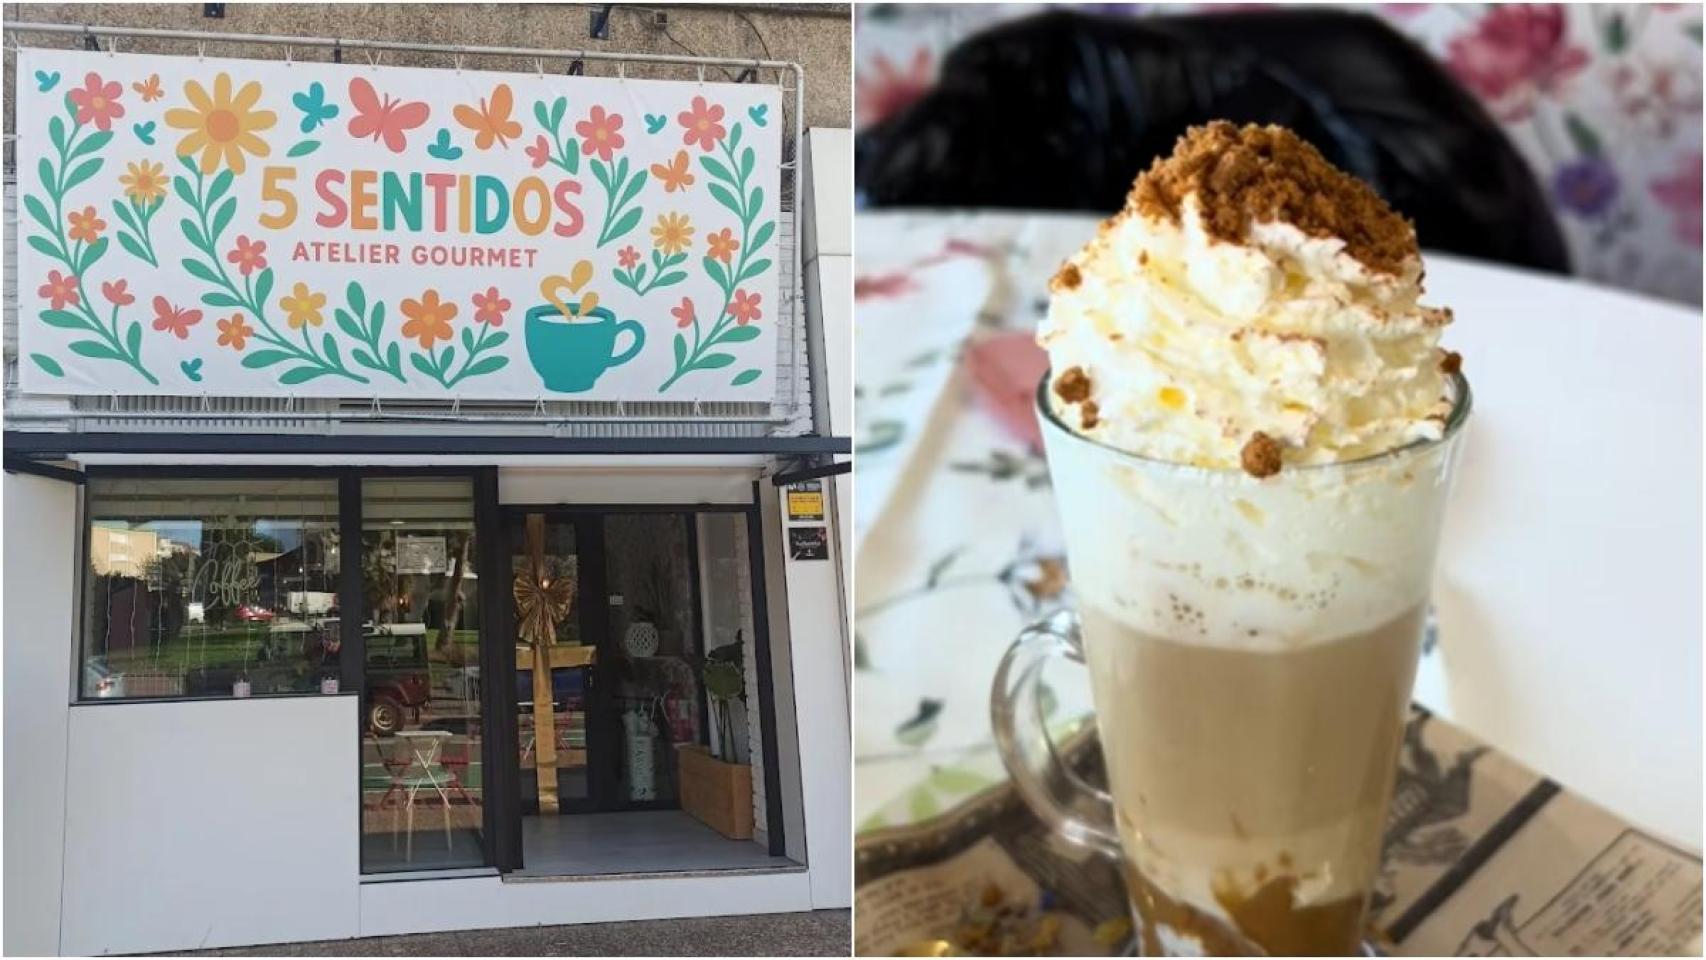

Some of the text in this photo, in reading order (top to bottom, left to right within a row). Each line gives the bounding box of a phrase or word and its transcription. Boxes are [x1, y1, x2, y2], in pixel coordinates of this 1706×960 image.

[258, 166, 584, 238] 5 SENTIDOS
[292, 241, 539, 269] ATELIER GOURMET
[191, 558, 268, 611] Coffee
